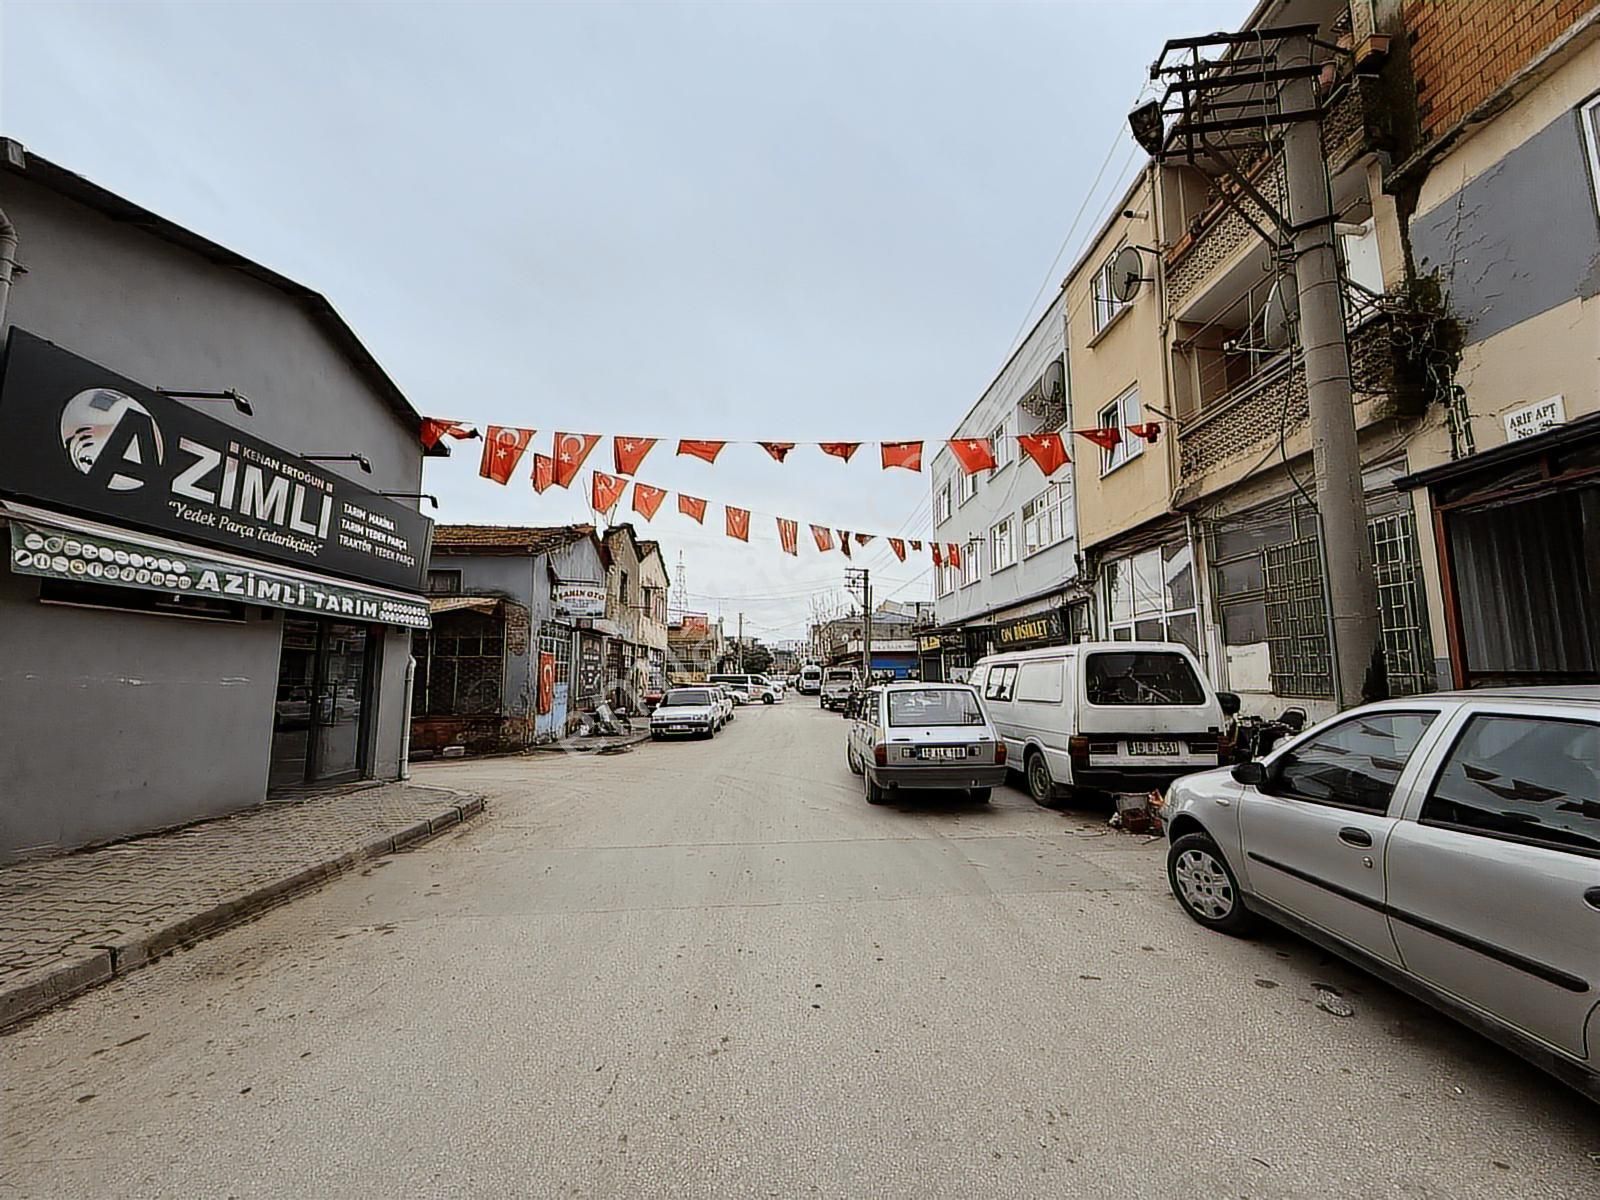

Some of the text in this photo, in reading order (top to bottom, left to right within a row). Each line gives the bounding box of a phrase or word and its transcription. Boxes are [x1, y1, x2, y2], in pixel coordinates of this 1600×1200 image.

[242, 447, 325, 489] KENAN ERTOĞUN
[343, 503, 367, 520] TARIM
[218, 516, 254, 538] Parça
[341, 519, 408, 551] TARIM YEDEK PARÇA
[374, 545, 396, 560] YEDEK
[396, 553, 415, 568] PARÇA
[195, 569, 378, 618] AZİMLİ TARIM
